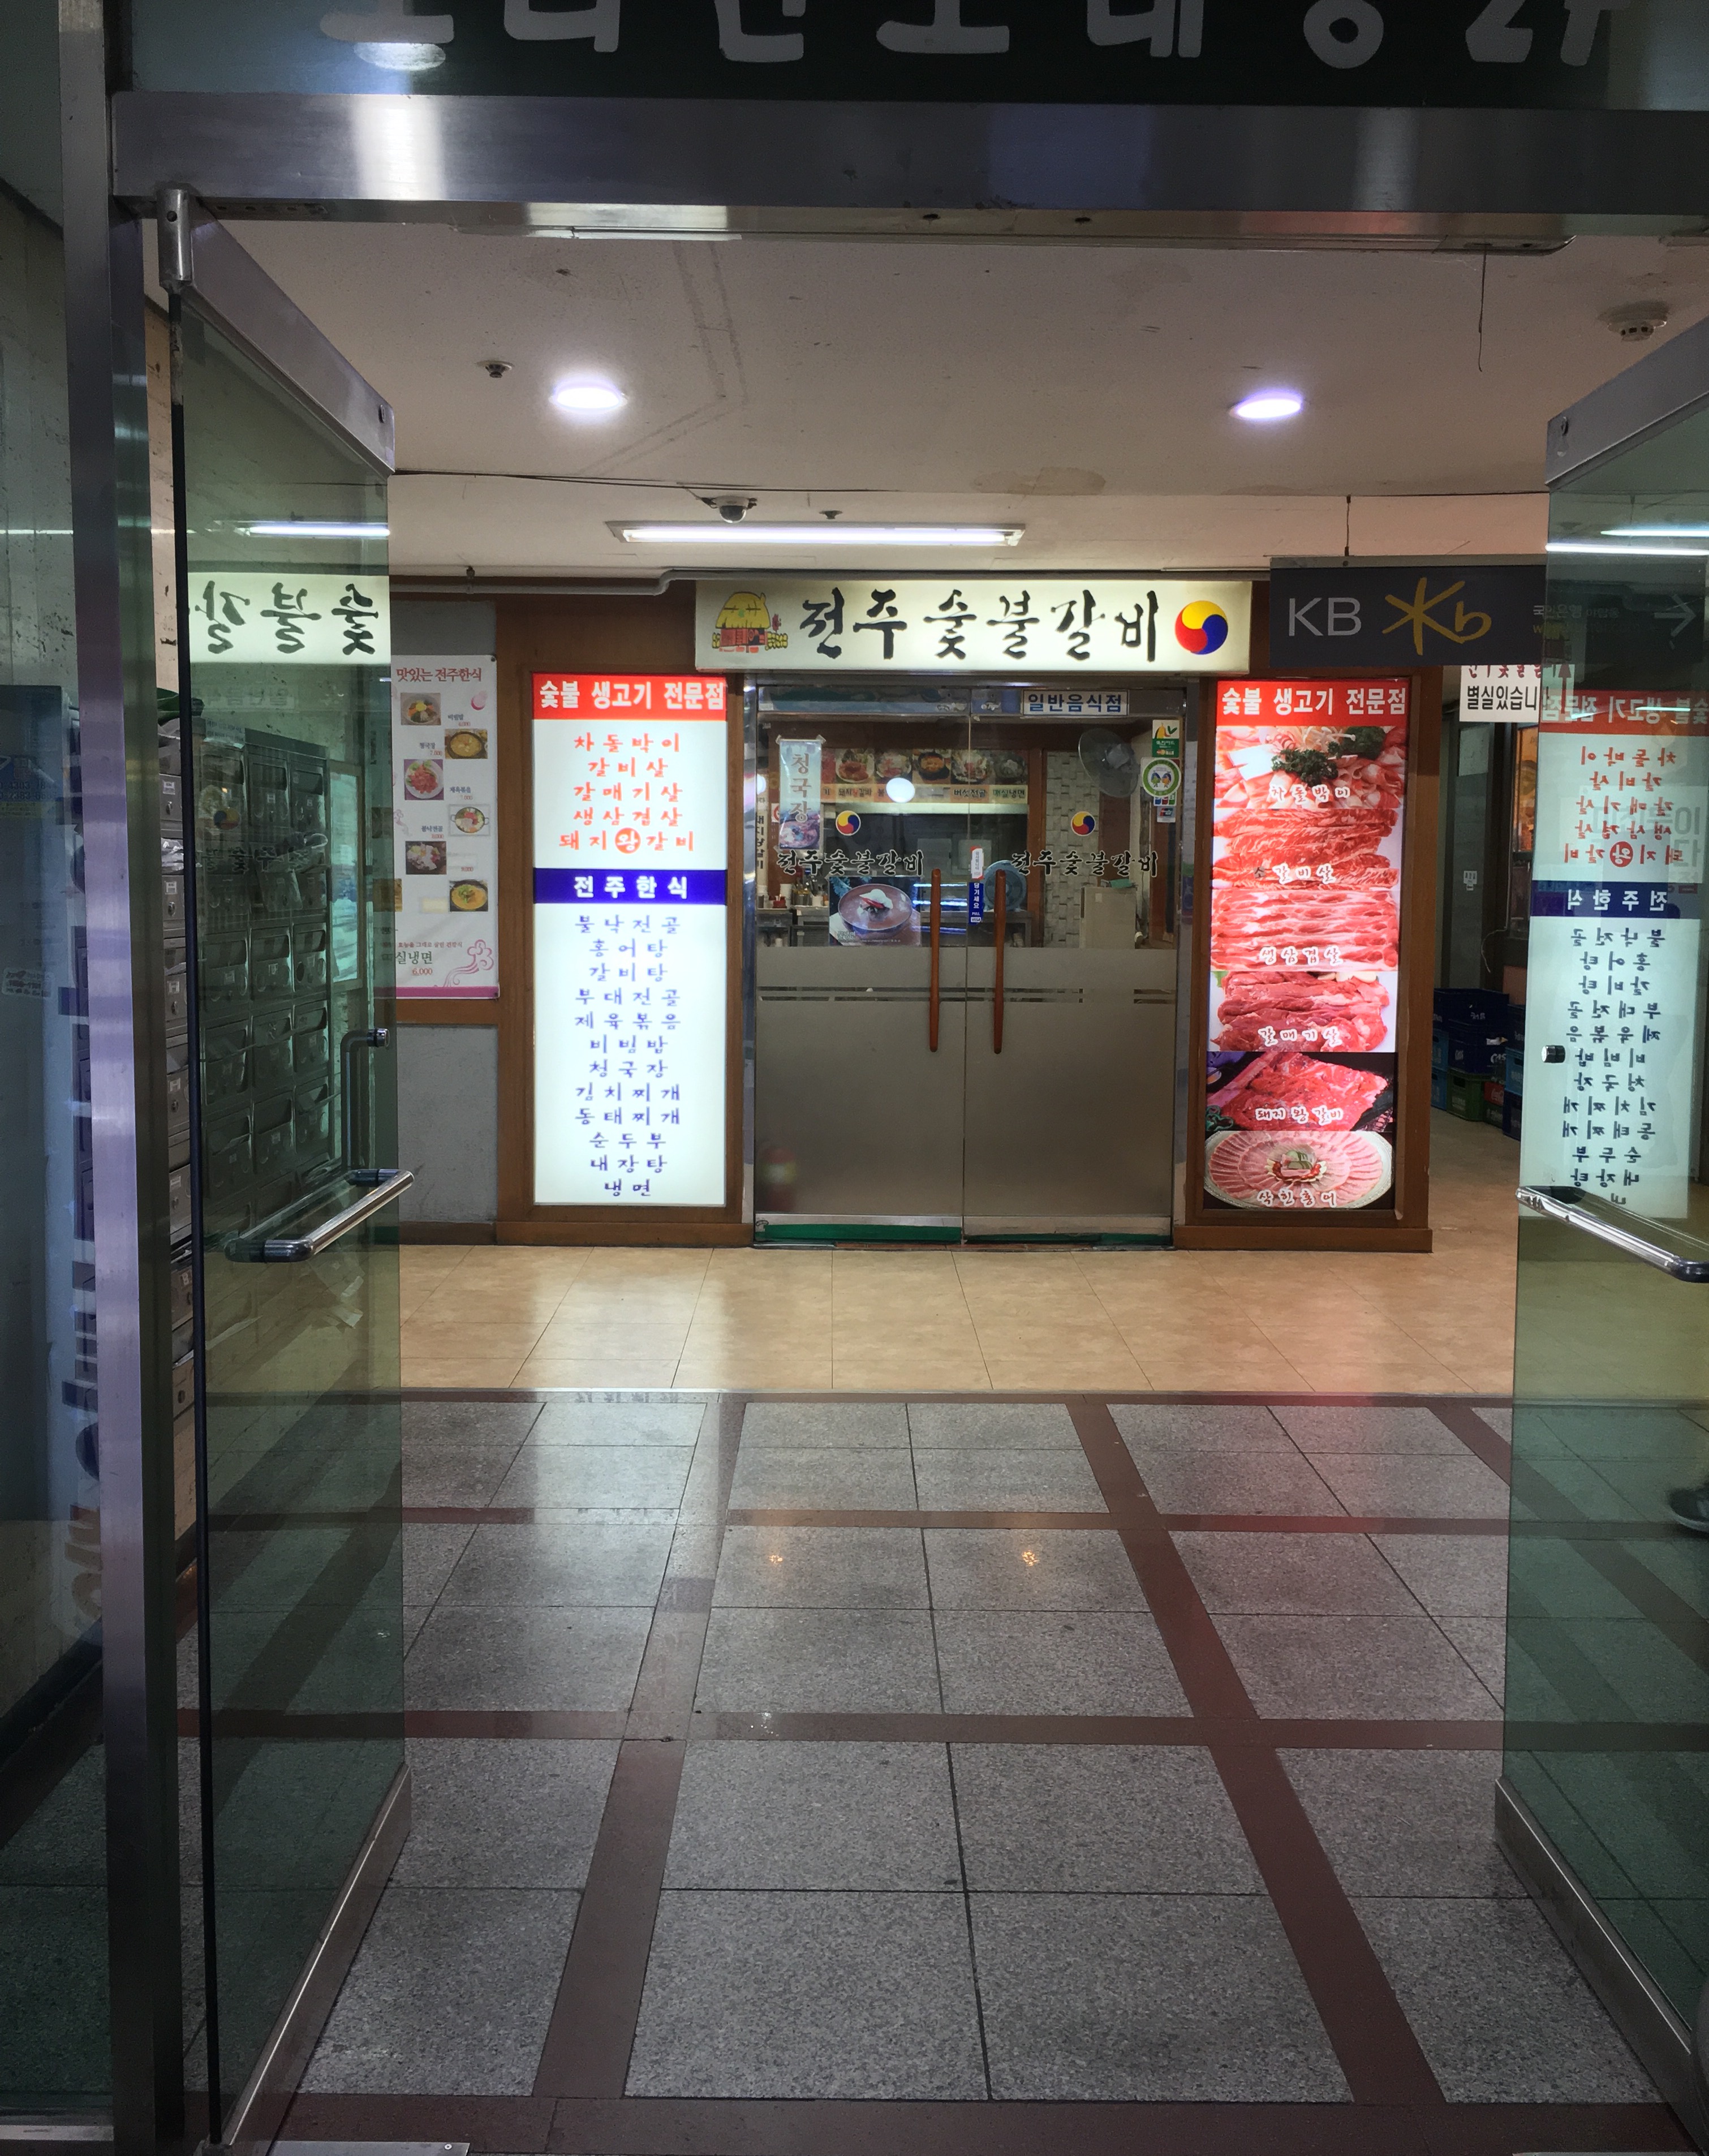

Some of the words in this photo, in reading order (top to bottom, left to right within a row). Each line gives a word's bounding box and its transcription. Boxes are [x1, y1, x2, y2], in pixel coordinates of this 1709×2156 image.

[1288, 596, 1362, 638] KB
[396, 668, 433, 682] 맛있는
[435, 668, 482, 682] 전주한식
[540, 681, 580, 709] 숯불
[591, 681, 652, 710] 생고기
[664, 682, 725, 710] 전문점
[1028, 693, 1122, 713] 일반음식점
[1222, 687, 1262, 716] 숯불
[1273, 688, 1334, 716] 생고기
[1346, 688, 1407, 715] 전문점
[1467, 686, 1549, 711] 별실있습니
[790, 752, 812, 824] 청국장
